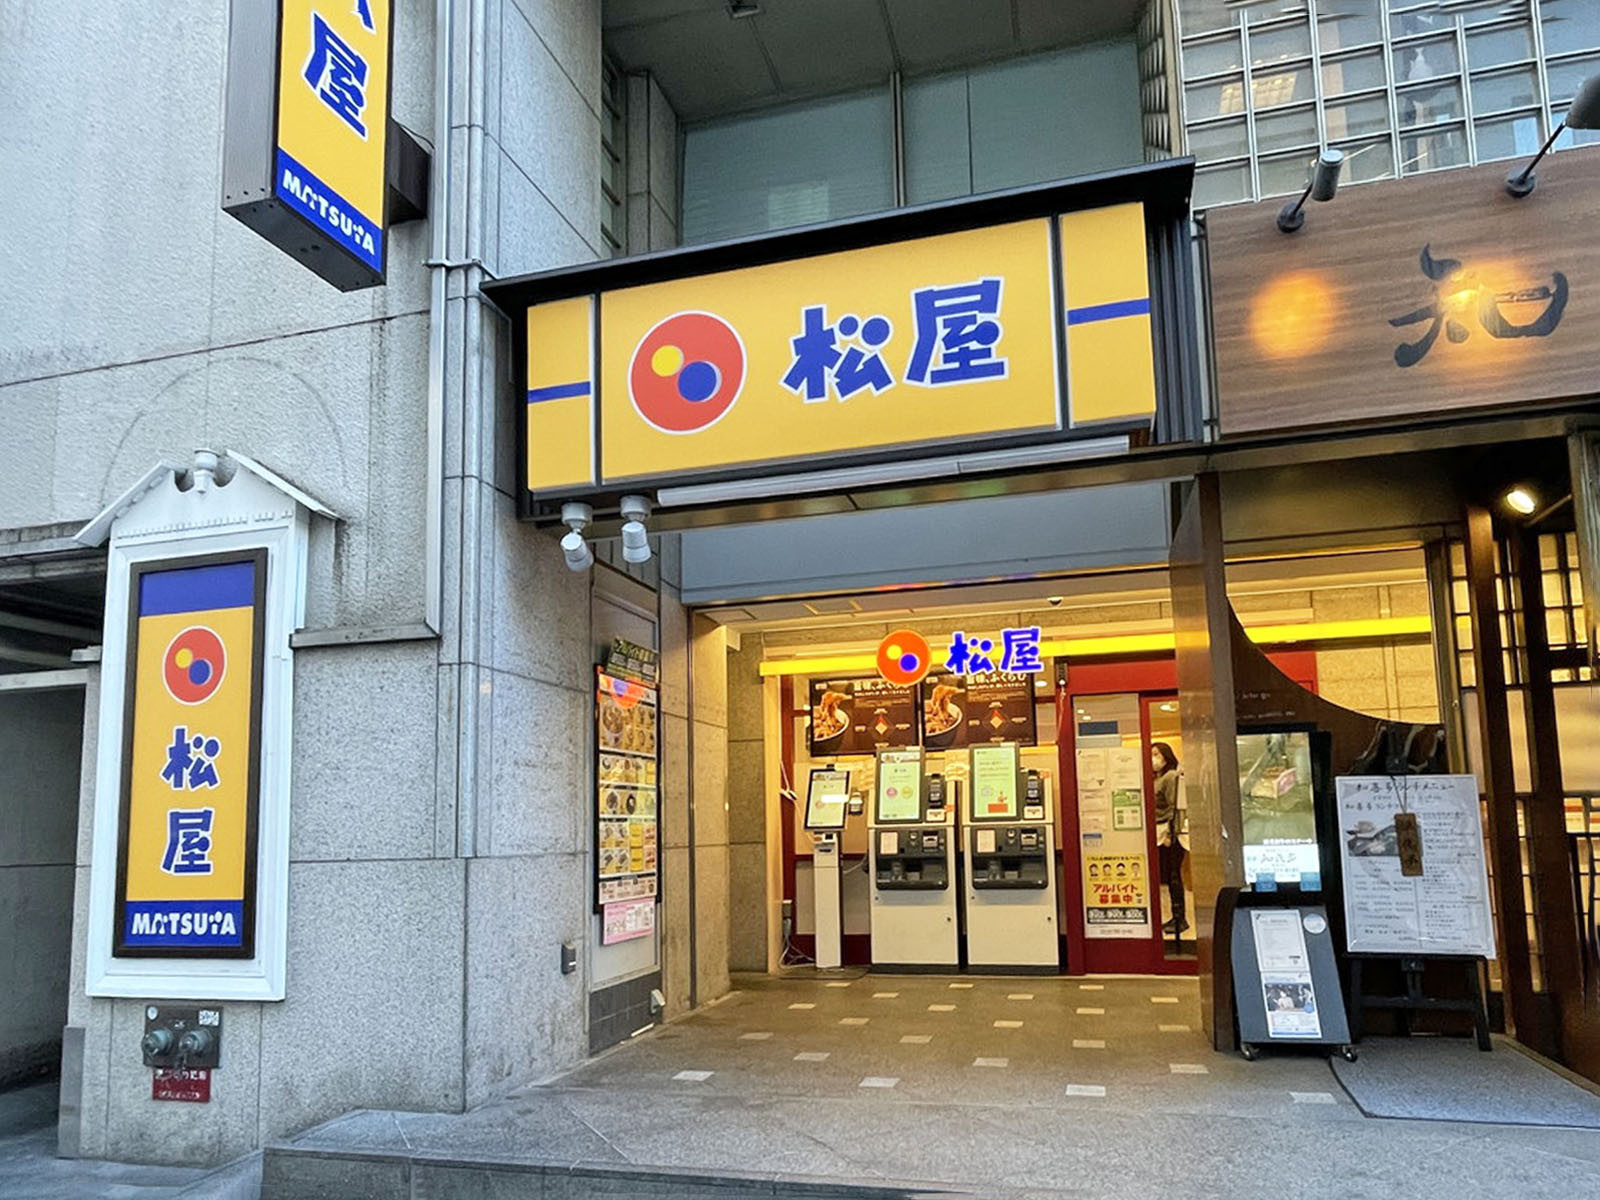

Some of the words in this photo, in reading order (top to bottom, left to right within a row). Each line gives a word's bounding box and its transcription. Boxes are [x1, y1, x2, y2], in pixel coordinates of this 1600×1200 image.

[302, 0, 376, 142] 屋
[282, 168, 376, 255] MATSUYA
[779, 276, 1008, 404] 松屋
[943, 625, 1044, 676] 松屋
[160, 725, 222, 876] 松屋
[131, 911, 237, 936] MATSUYA
